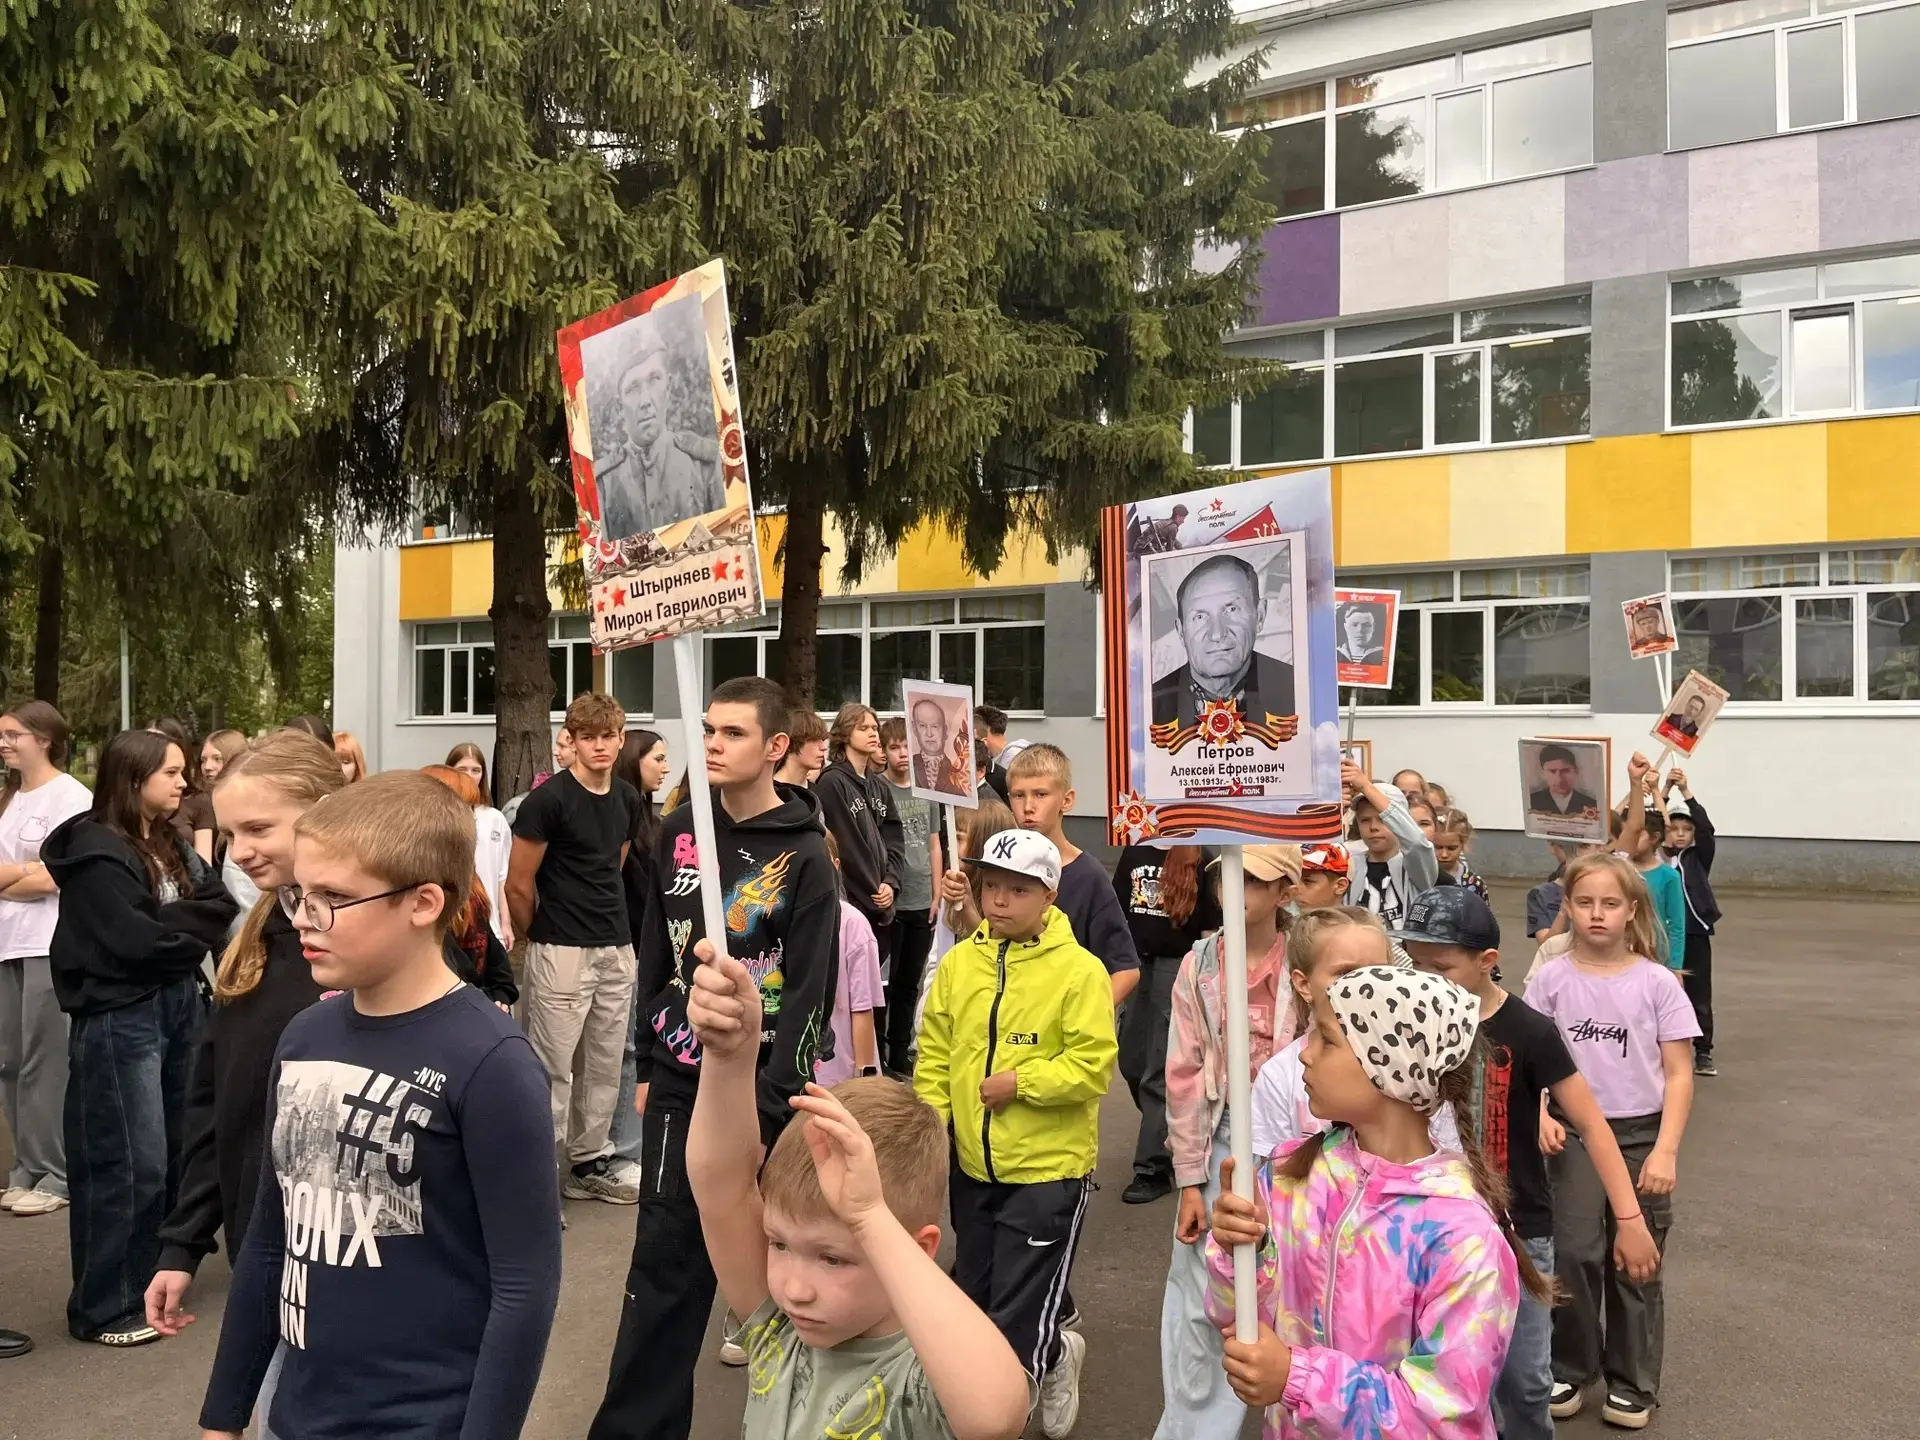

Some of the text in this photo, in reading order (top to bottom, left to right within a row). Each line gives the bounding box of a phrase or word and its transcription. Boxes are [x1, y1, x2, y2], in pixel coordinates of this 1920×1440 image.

[630, 566, 711, 599] Штырняев
[604, 586, 747, 633] Мирон Гаврилович
[1198, 746, 1254, 760] Петров
[1170, 762, 1285, 777] Алексей Ефремович
[992, 835, 1018, 859] NY
[98, 1333, 134, 1344] rocs
